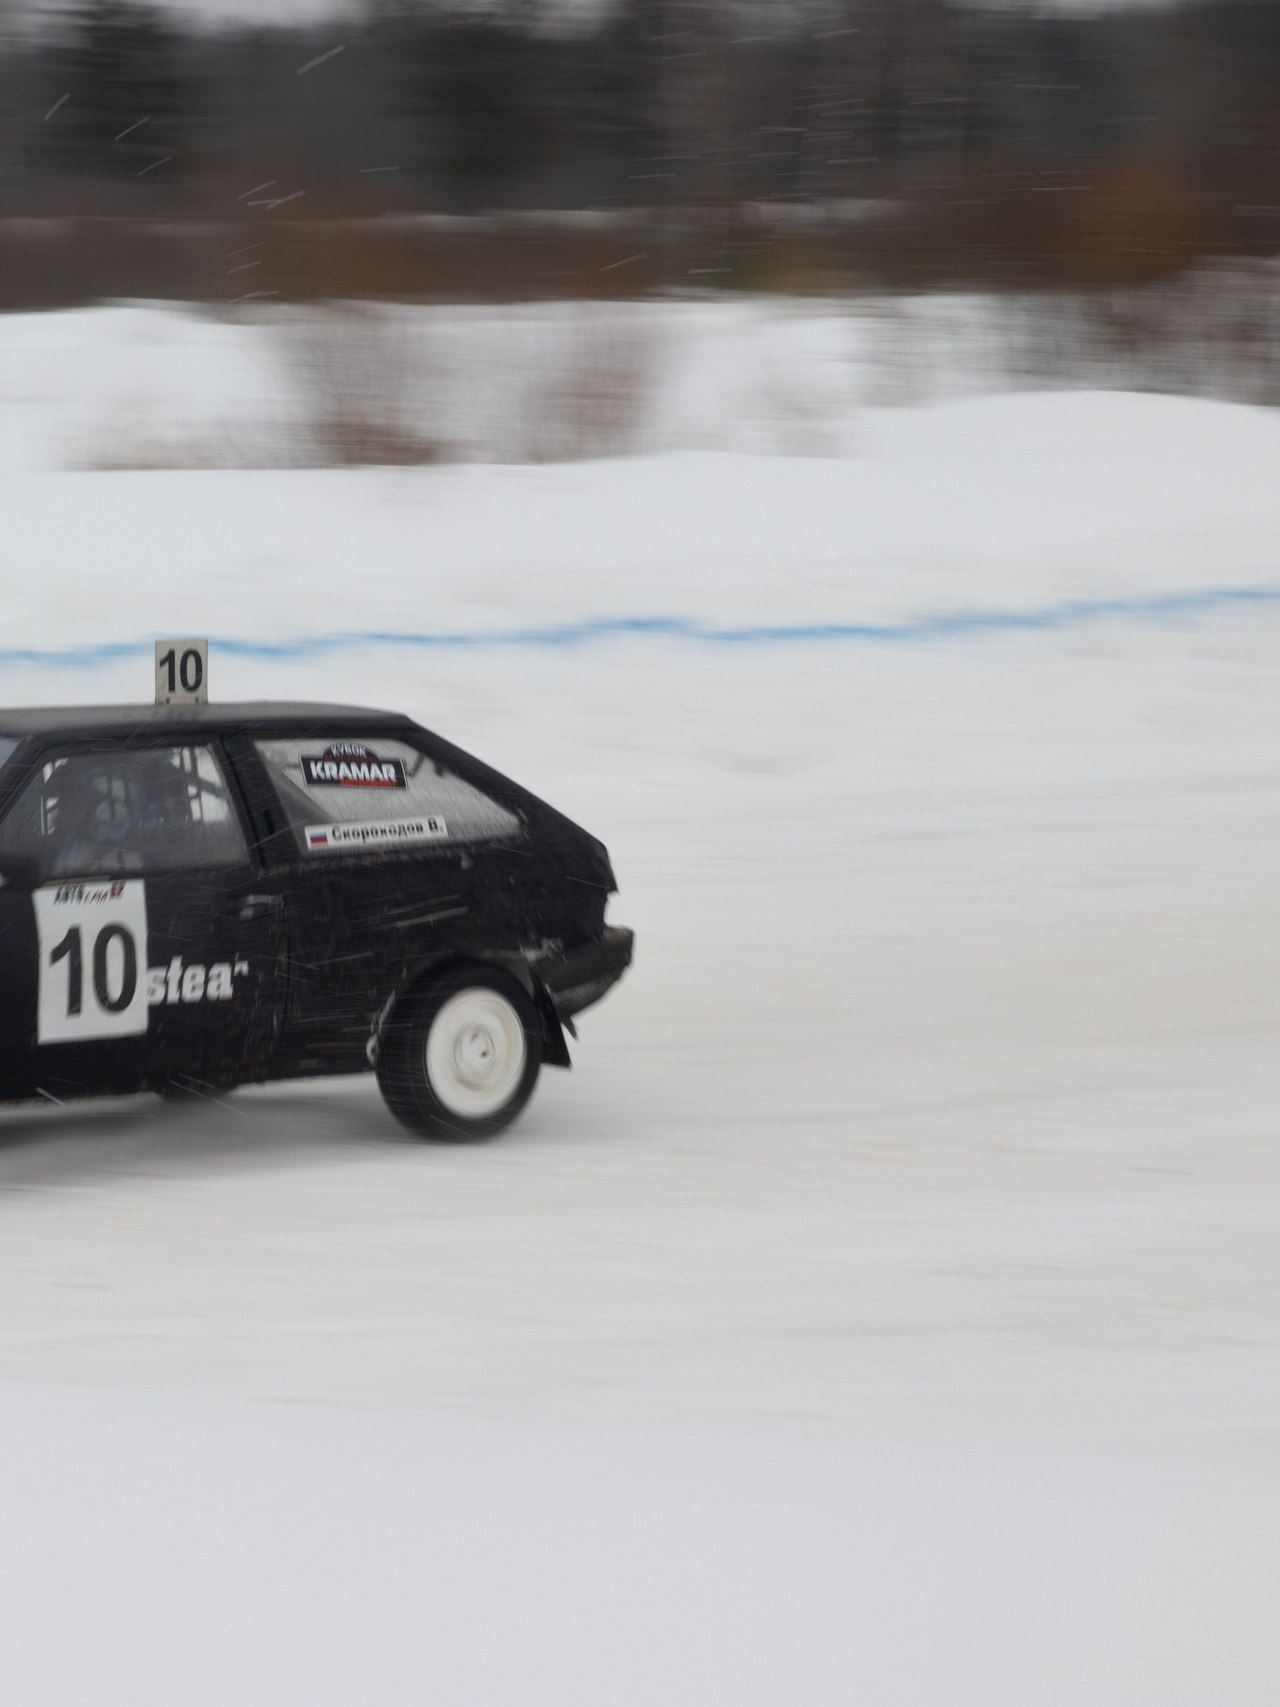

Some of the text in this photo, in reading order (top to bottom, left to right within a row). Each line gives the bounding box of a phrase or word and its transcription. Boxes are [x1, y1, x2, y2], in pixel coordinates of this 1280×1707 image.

[159, 648, 203, 693] 10
[310, 760, 397, 782] KRAMAR
[331, 823, 424, 844] Скороходов
[48, 921, 137, 1018] 10
